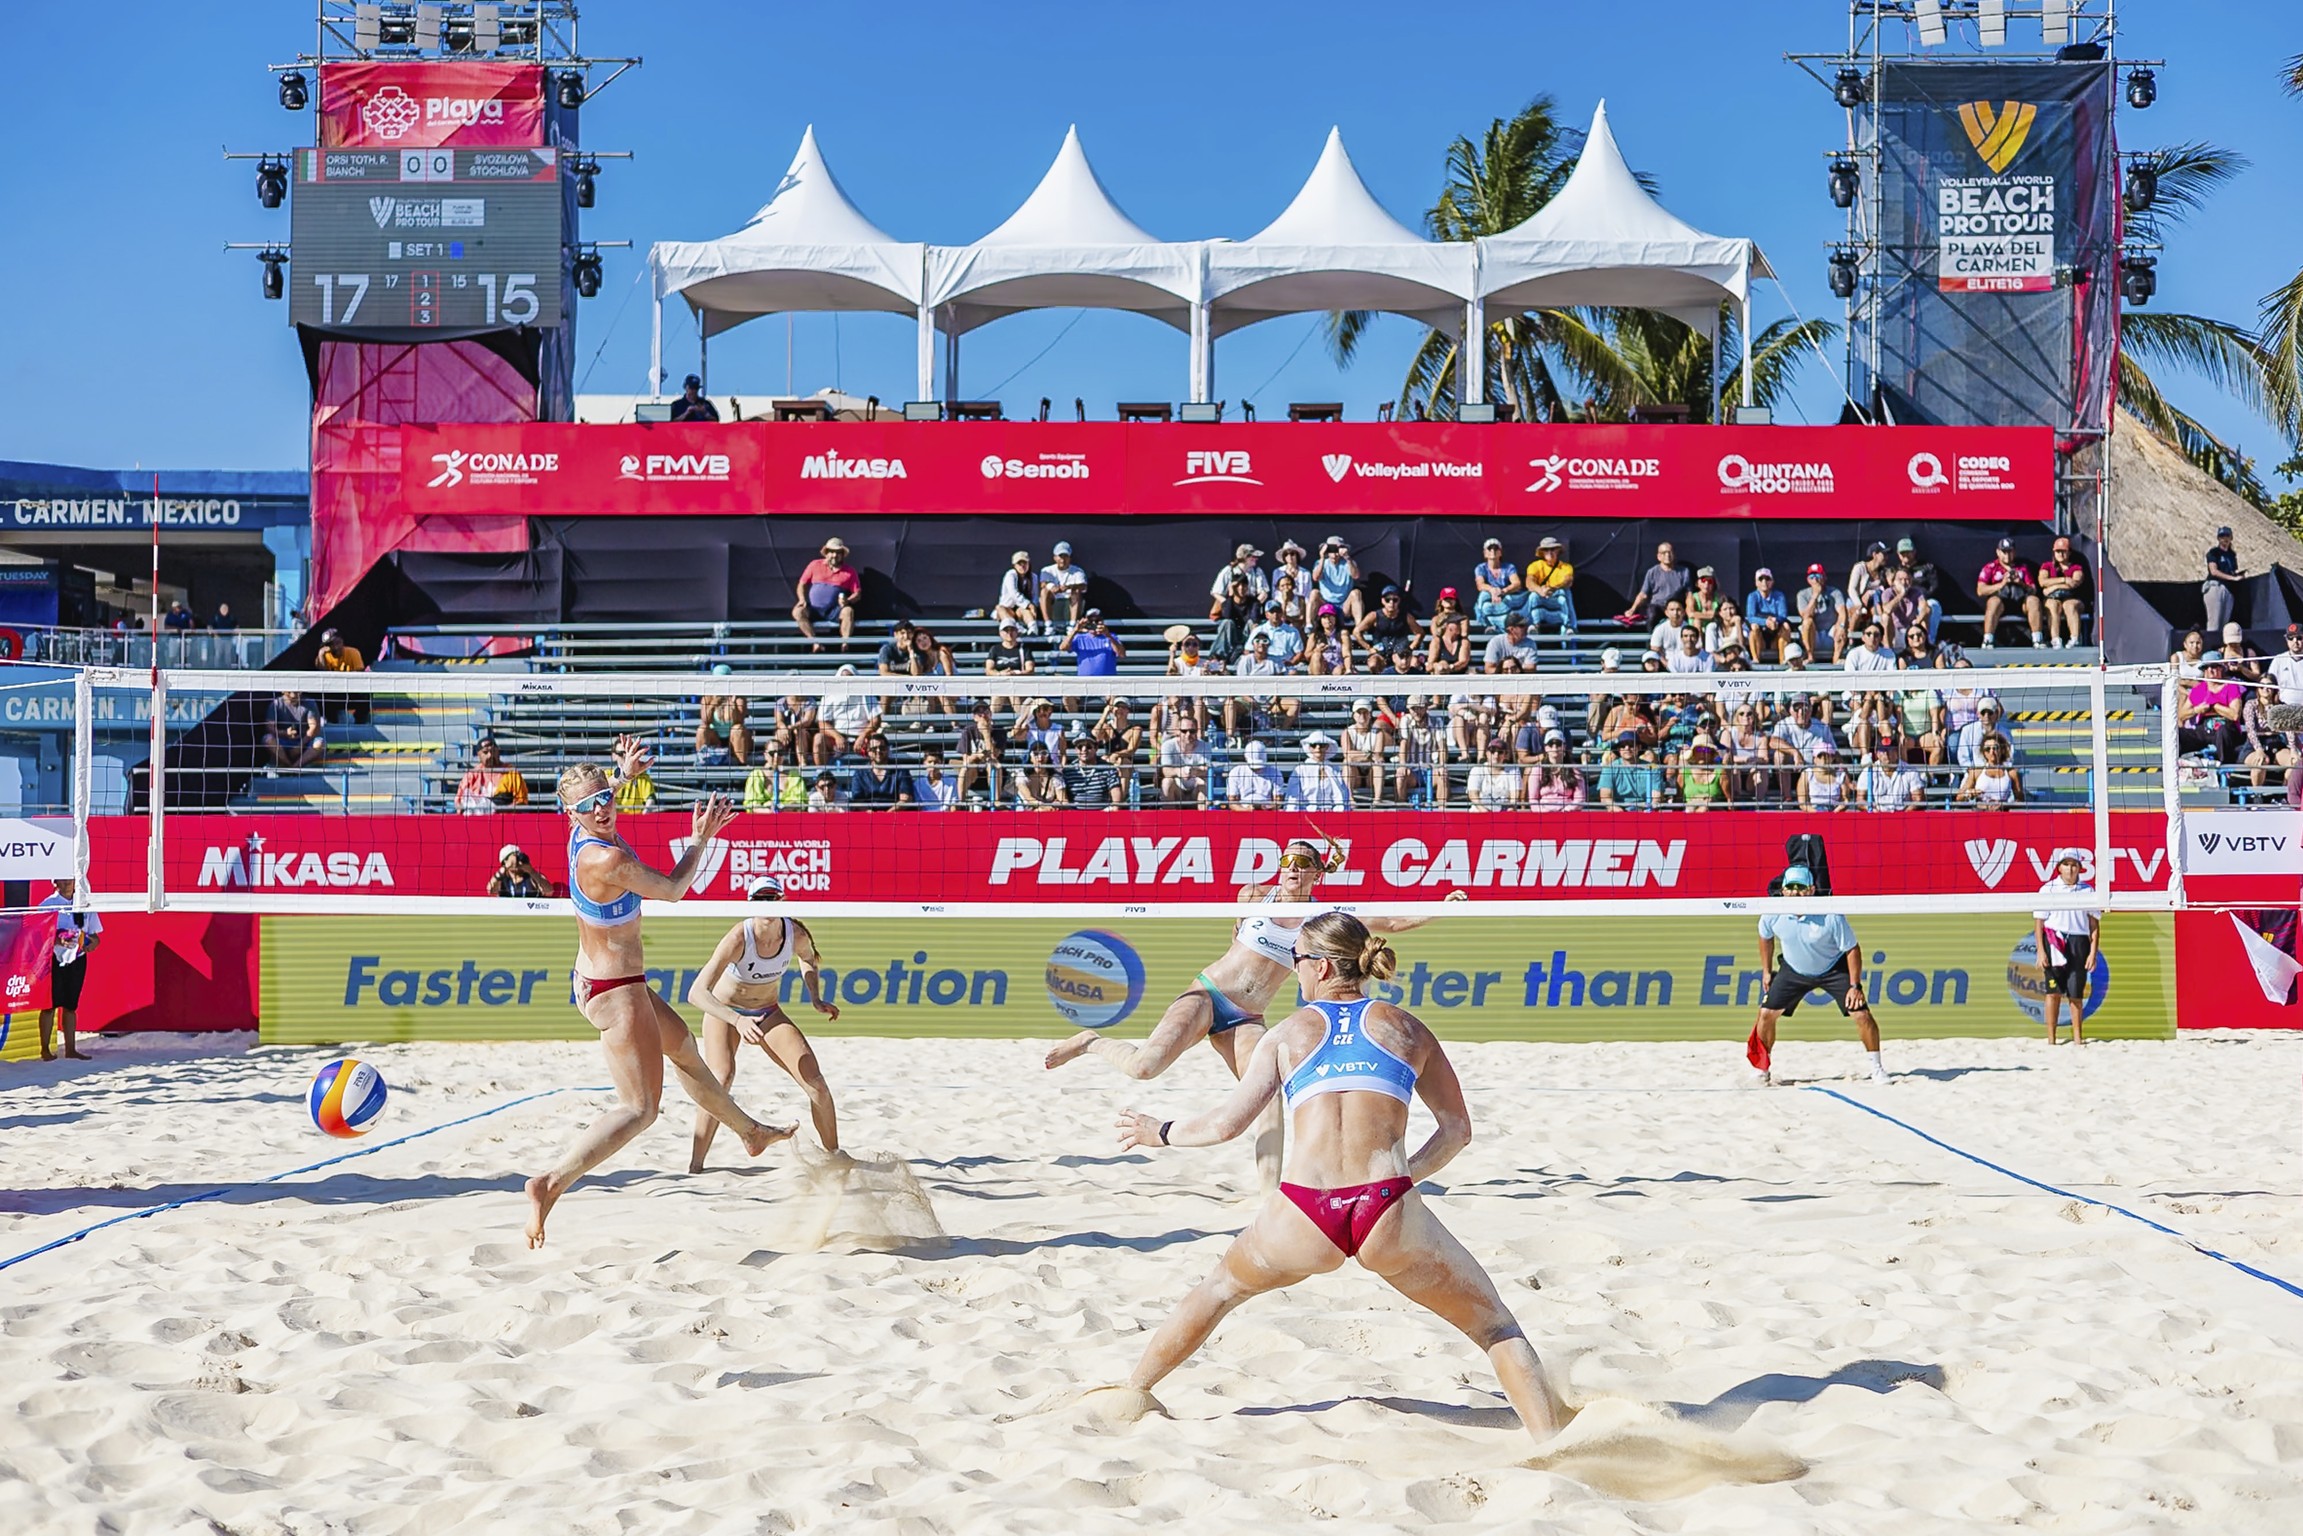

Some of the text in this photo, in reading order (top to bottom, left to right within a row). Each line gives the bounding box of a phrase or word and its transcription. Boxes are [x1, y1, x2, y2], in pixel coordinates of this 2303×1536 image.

[426, 96, 503, 126] Playa
[407, 156, 421, 173] 0
[433, 156, 448, 173] 0
[474, 154, 529, 165] SVOZILOVA
[326, 165, 366, 176] BIANCHI
[469, 165, 529, 176] STOCHLOVA
[1940, 175, 2054, 188] VOLLEYBALL WORLD
[1939, 186, 2055, 215] BEACH
[395, 204, 441, 217] BEACH
[395, 217, 415, 227] PRO
[415, 217, 441, 227] TOUR
[1939, 213, 2055, 234] PRO TOUR
[406, 245, 444, 256] SET 1
[1948, 241, 2046, 256] PLAYA DEL
[1955, 257, 2037, 272] CARMEN
[385, 275, 399, 288] 17
[422, 275, 429, 288] 1
[451, 275, 467, 288] 15
[1967, 278, 2024, 290] ELITE16
[314, 274, 370, 325] 17
[420, 292, 431, 307] 2
[477, 274, 541, 325] 15
[420, 310, 431, 324] 3
[469, 453, 559, 472] CONADE
[646, 455, 731, 475] FMVB
[1004, 459, 1090, 479] Senoh
[1187, 451, 1251, 475] FIVB
[1568, 458, 1660, 477] CONADE
[1353, 462, 1483, 481] Volleyball World
[1717, 454, 1835, 488] QUINTANA
[1749, 478, 1791, 494] ROO
[14, 499, 133, 525] CARMEN.
[0, 571, 49, 581] TUESDAY
[915, 684, 939, 692] VBTV
[1727, 680, 1752, 688] VBTV
[0, 841, 56, 858] VBTV
[731, 840, 831, 849] VOLLEYBALL WORLD
[2226, 836, 2288, 852] VBTV
[730, 848, 832, 874] BEACH
[988, 836, 1688, 888] PLAYA DL CARMEN
[775, 873, 831, 891] TOUR
[1251, 920, 1265, 930] 2
[747, 961, 756, 971] 1
[8, 974, 27, 988] dry
[343, 955, 548, 1006] Faster
[778, 950, 1008, 1006] motion
[1523, 950, 1673, 1007] than
[5, 985, 23, 998] up
[1338, 1016, 1351, 1034] 1
[1333, 1033, 1355, 1046] CZE
[1333, 1061, 1379, 1074] VBTV
